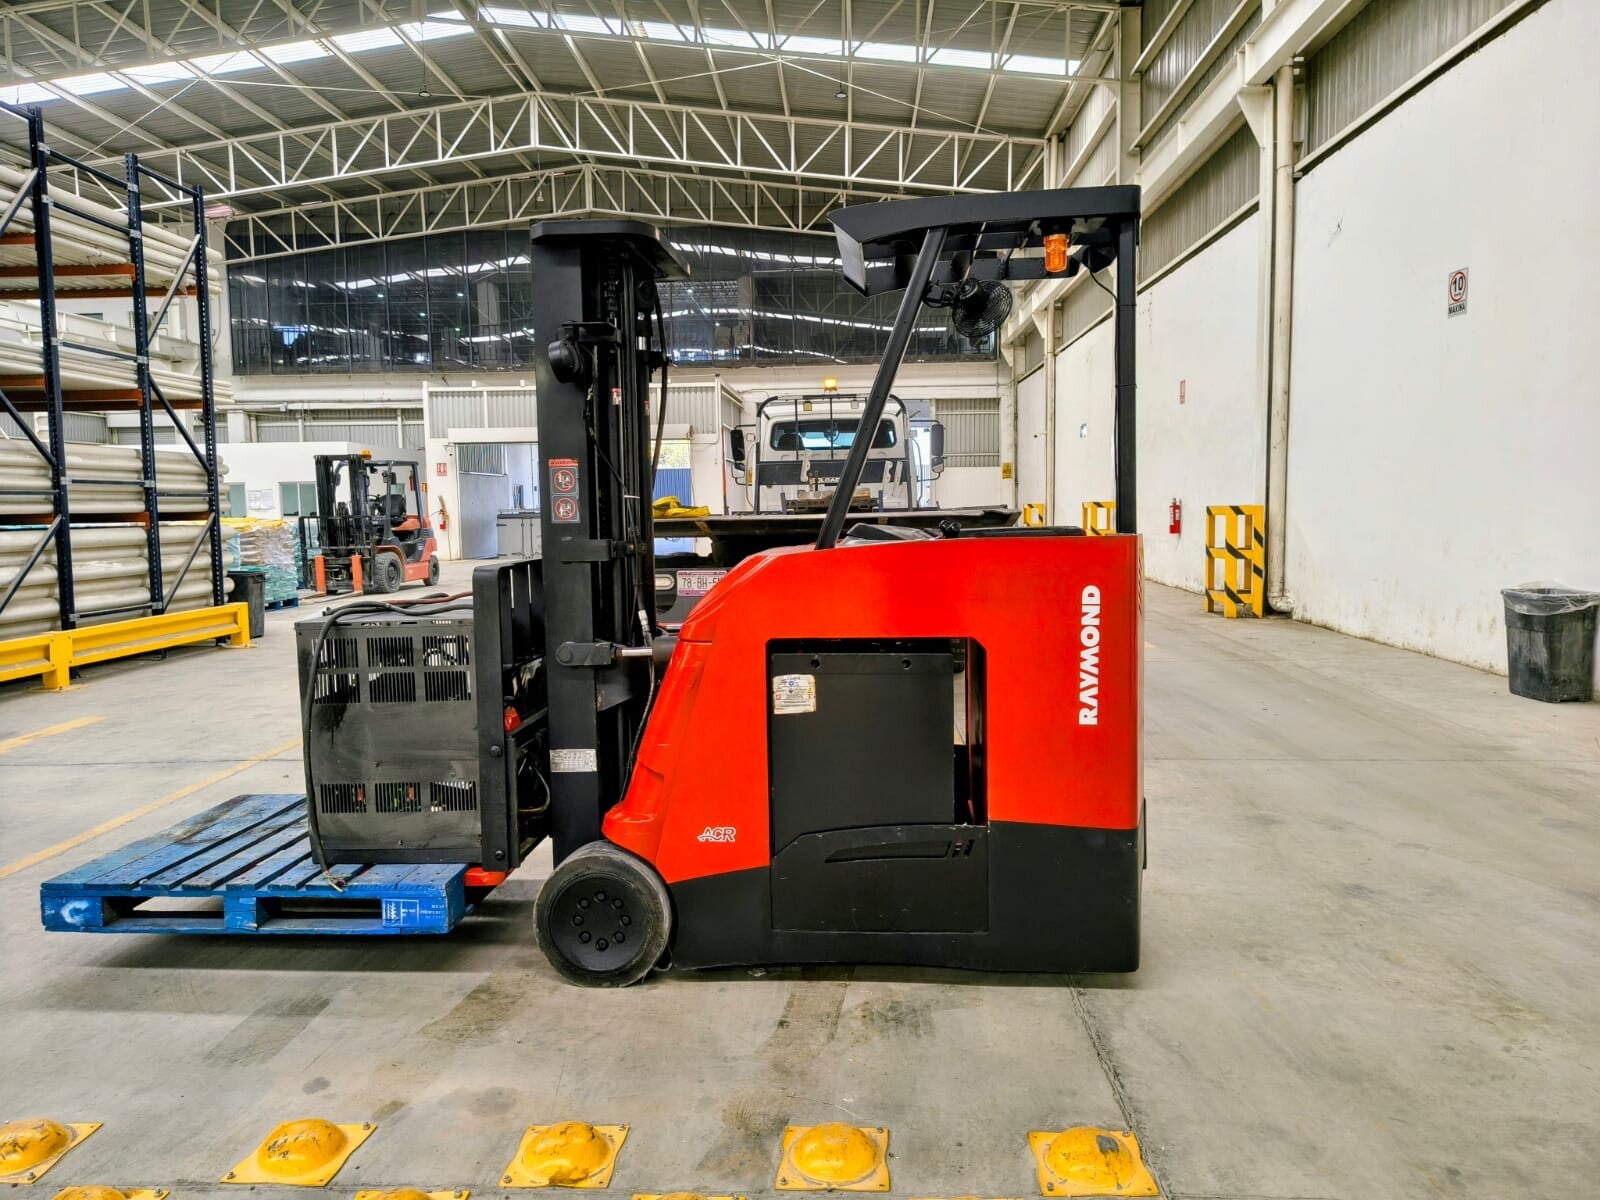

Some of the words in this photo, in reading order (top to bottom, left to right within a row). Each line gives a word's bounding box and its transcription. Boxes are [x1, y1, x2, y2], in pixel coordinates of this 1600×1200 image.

[1452, 275, 1464, 293] 10
[1078, 585, 1101, 726] RAYMOND
[697, 826, 737, 842] ACR
